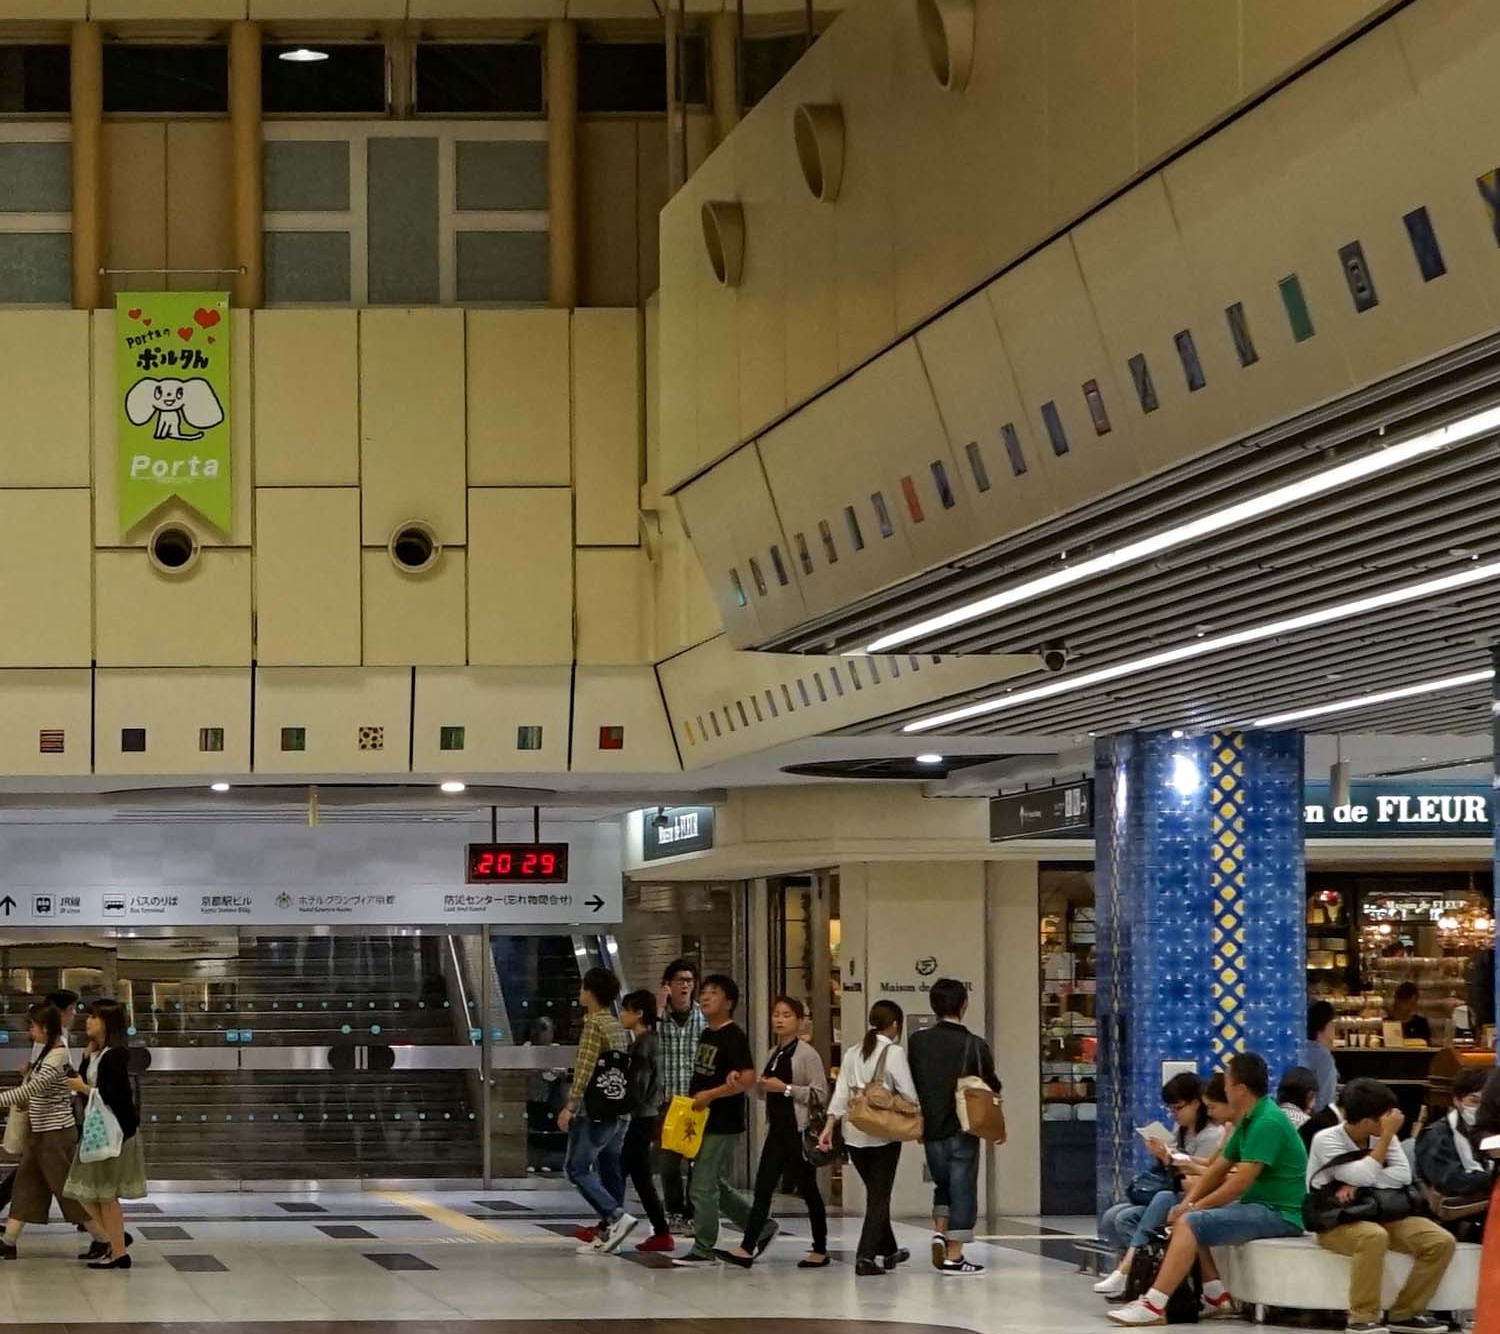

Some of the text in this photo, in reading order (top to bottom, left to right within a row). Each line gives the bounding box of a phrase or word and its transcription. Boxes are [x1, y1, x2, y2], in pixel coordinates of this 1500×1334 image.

[136, 346, 209, 371] ポルタん
[130, 455, 219, 478] Porta
[1333, 804, 1368, 823] de
[1376, 795, 1488, 823] FLEUR
[130, 896, 179, 907] バスのりば
[879, 981, 916, 993] Maison
